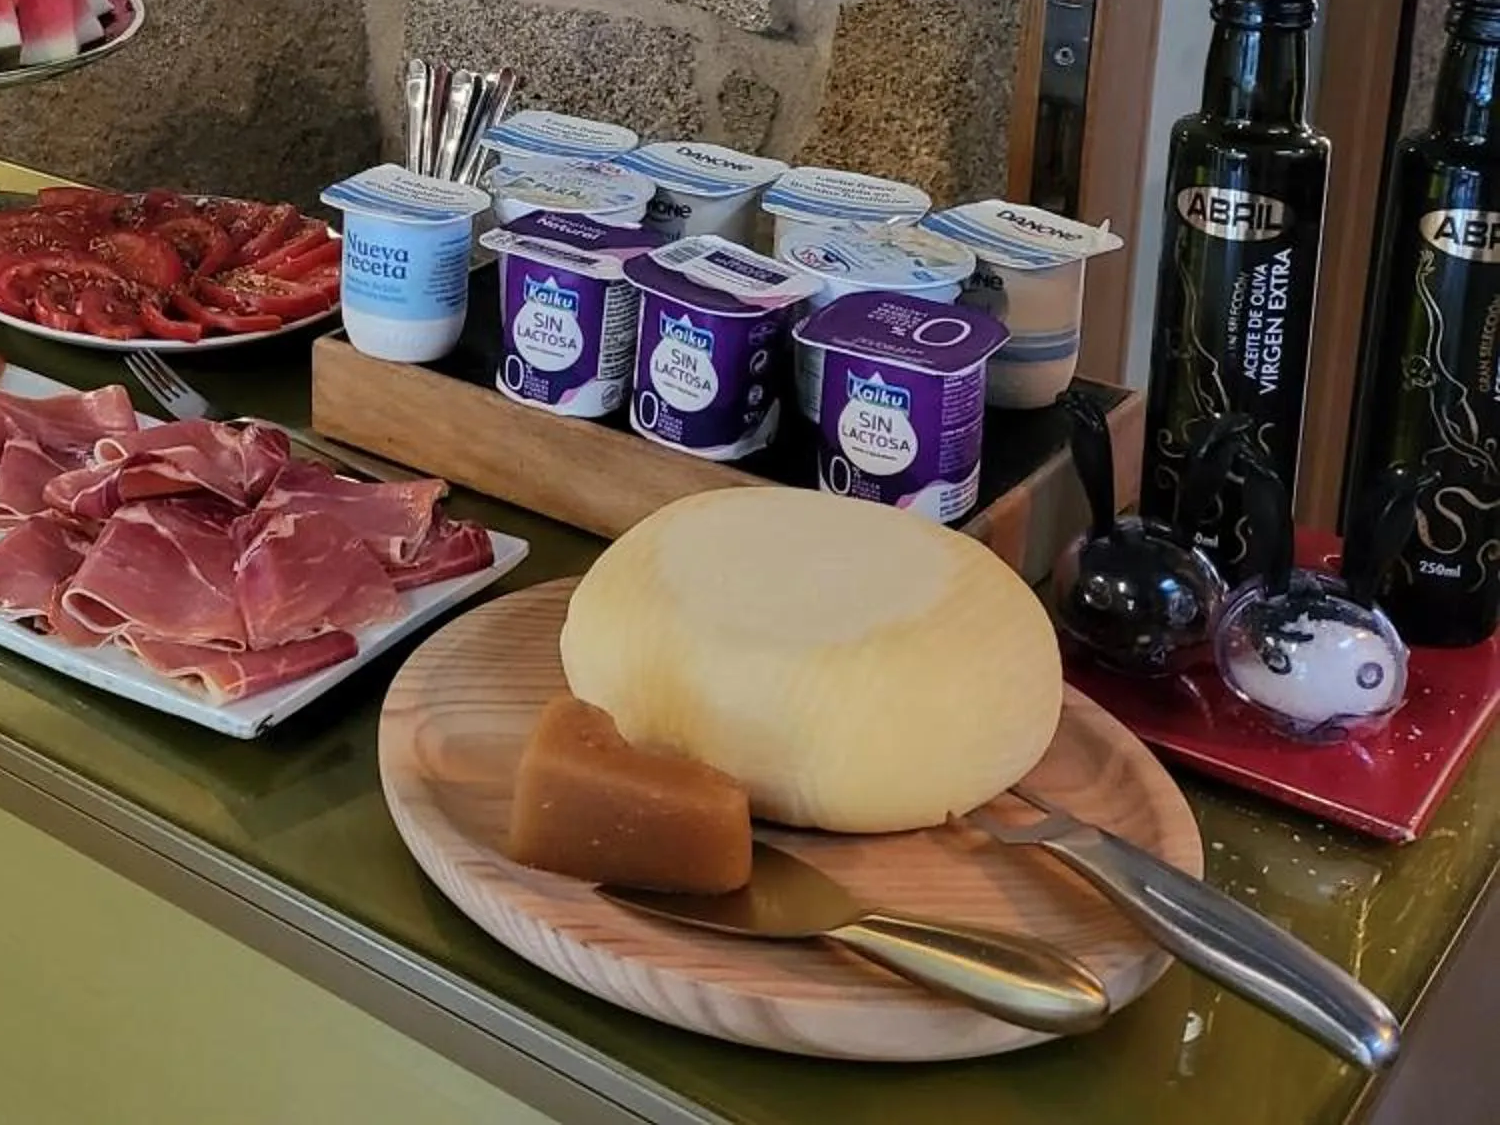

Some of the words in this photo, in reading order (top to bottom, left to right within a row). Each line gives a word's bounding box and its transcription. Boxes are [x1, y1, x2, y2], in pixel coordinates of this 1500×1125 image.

[1187, 192, 1284, 230] ABRIL
[347, 229, 409, 263] Nueva
[347, 255, 407, 280] receta
[1267, 248, 1292, 310] EXTRA
[528, 284, 574, 308] Kaiku
[1250, 263, 1269, 305] OLIVA
[533, 312, 563, 333] SIN
[1248, 309, 1264, 328] DE
[517, 324, 577, 350] LACTOSA
[664, 322, 708, 347] Kaiku
[671, 348, 698, 373] SIN
[1244, 328, 1261, 379] ACEITE
[1259, 317, 1285, 395] VIRGEN
[655, 361, 712, 391] LACTOSA
[851, 381, 904, 406] Kaiku
[859, 411, 893, 433] SIN
[842, 427, 910, 452] LACTOSA
[1419, 560, 1461, 577] 250ml
